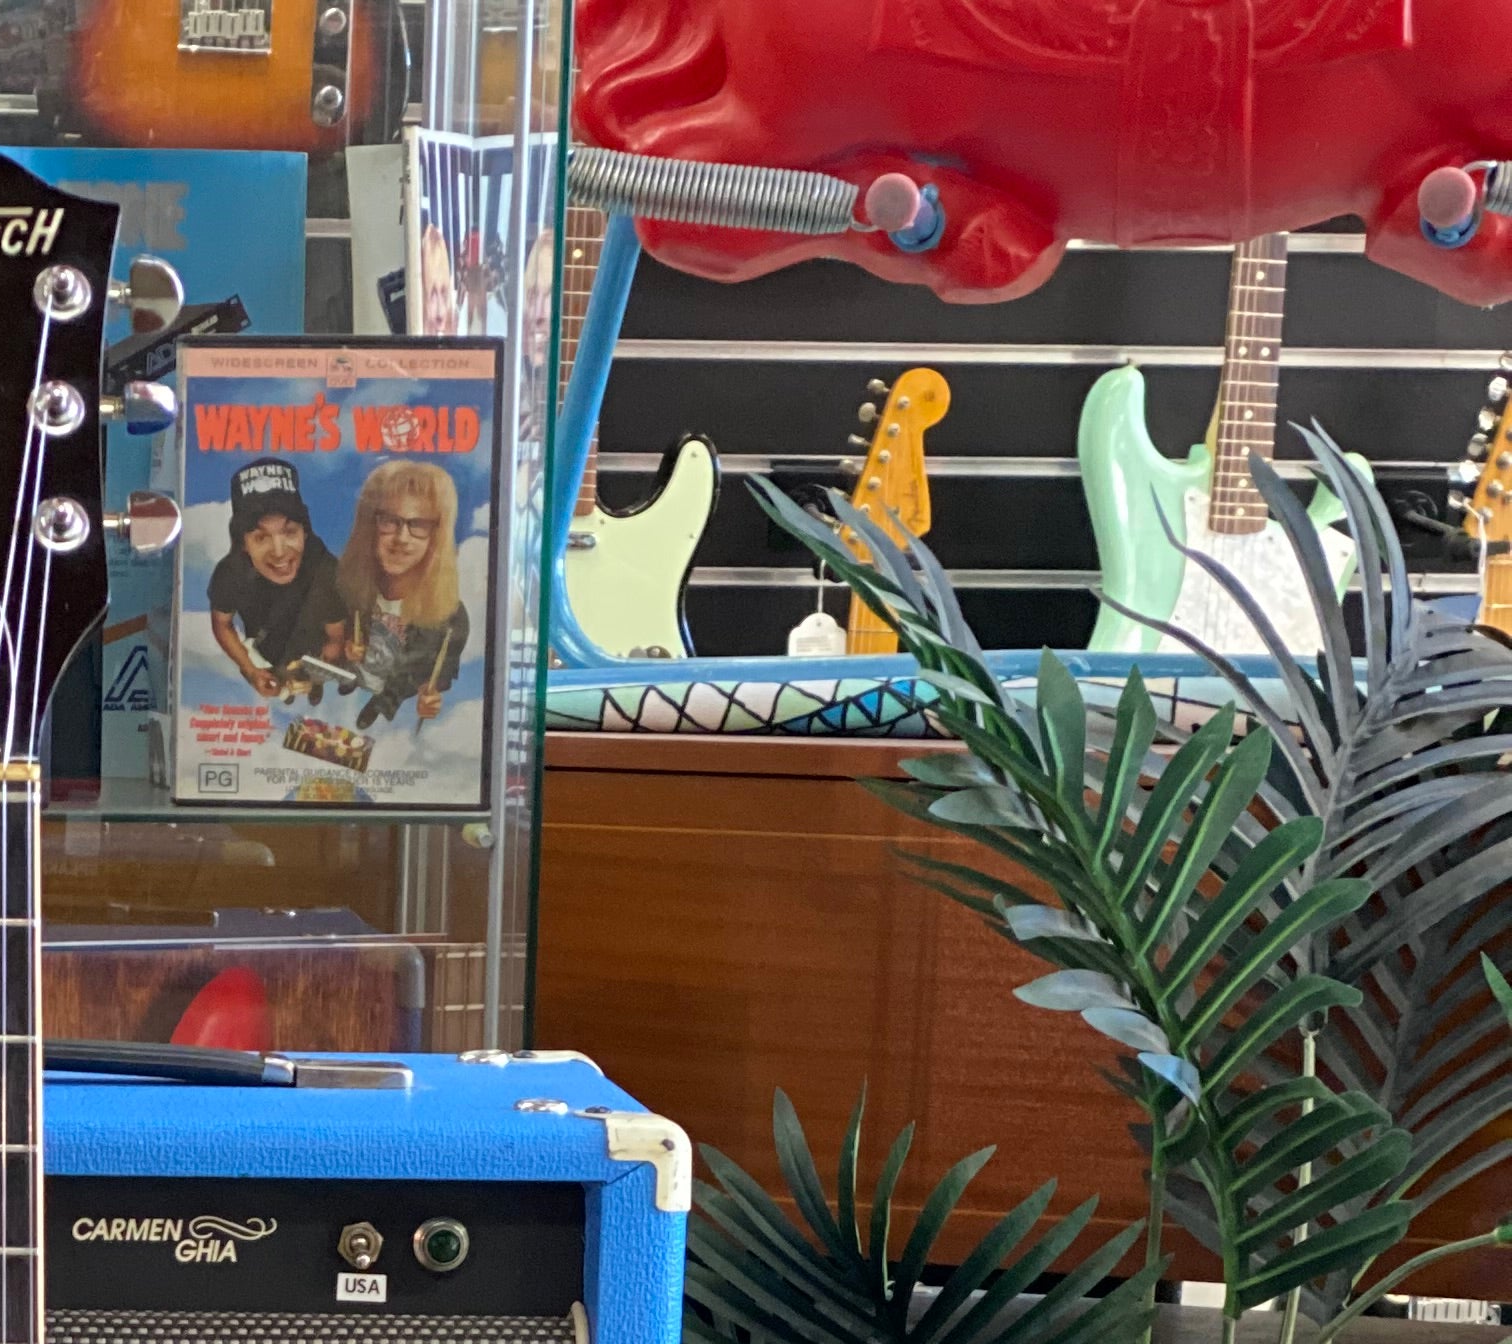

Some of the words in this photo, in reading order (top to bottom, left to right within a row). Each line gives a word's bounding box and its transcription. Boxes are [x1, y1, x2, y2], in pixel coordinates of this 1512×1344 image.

[211, 356, 319, 370] WIDESCREEN
[365, 357, 471, 371] COLECTION
[194, 391, 342, 452] WAYNE'S
[353, 404, 481, 453] WORLD
[205, 770, 233, 787] PG
[355, 769, 429, 779] RCOMMENDED
[72, 1217, 183, 1242] CARMEN
[175, 1239, 238, 1263] GHIA
[344, 1277, 381, 1295] USA
